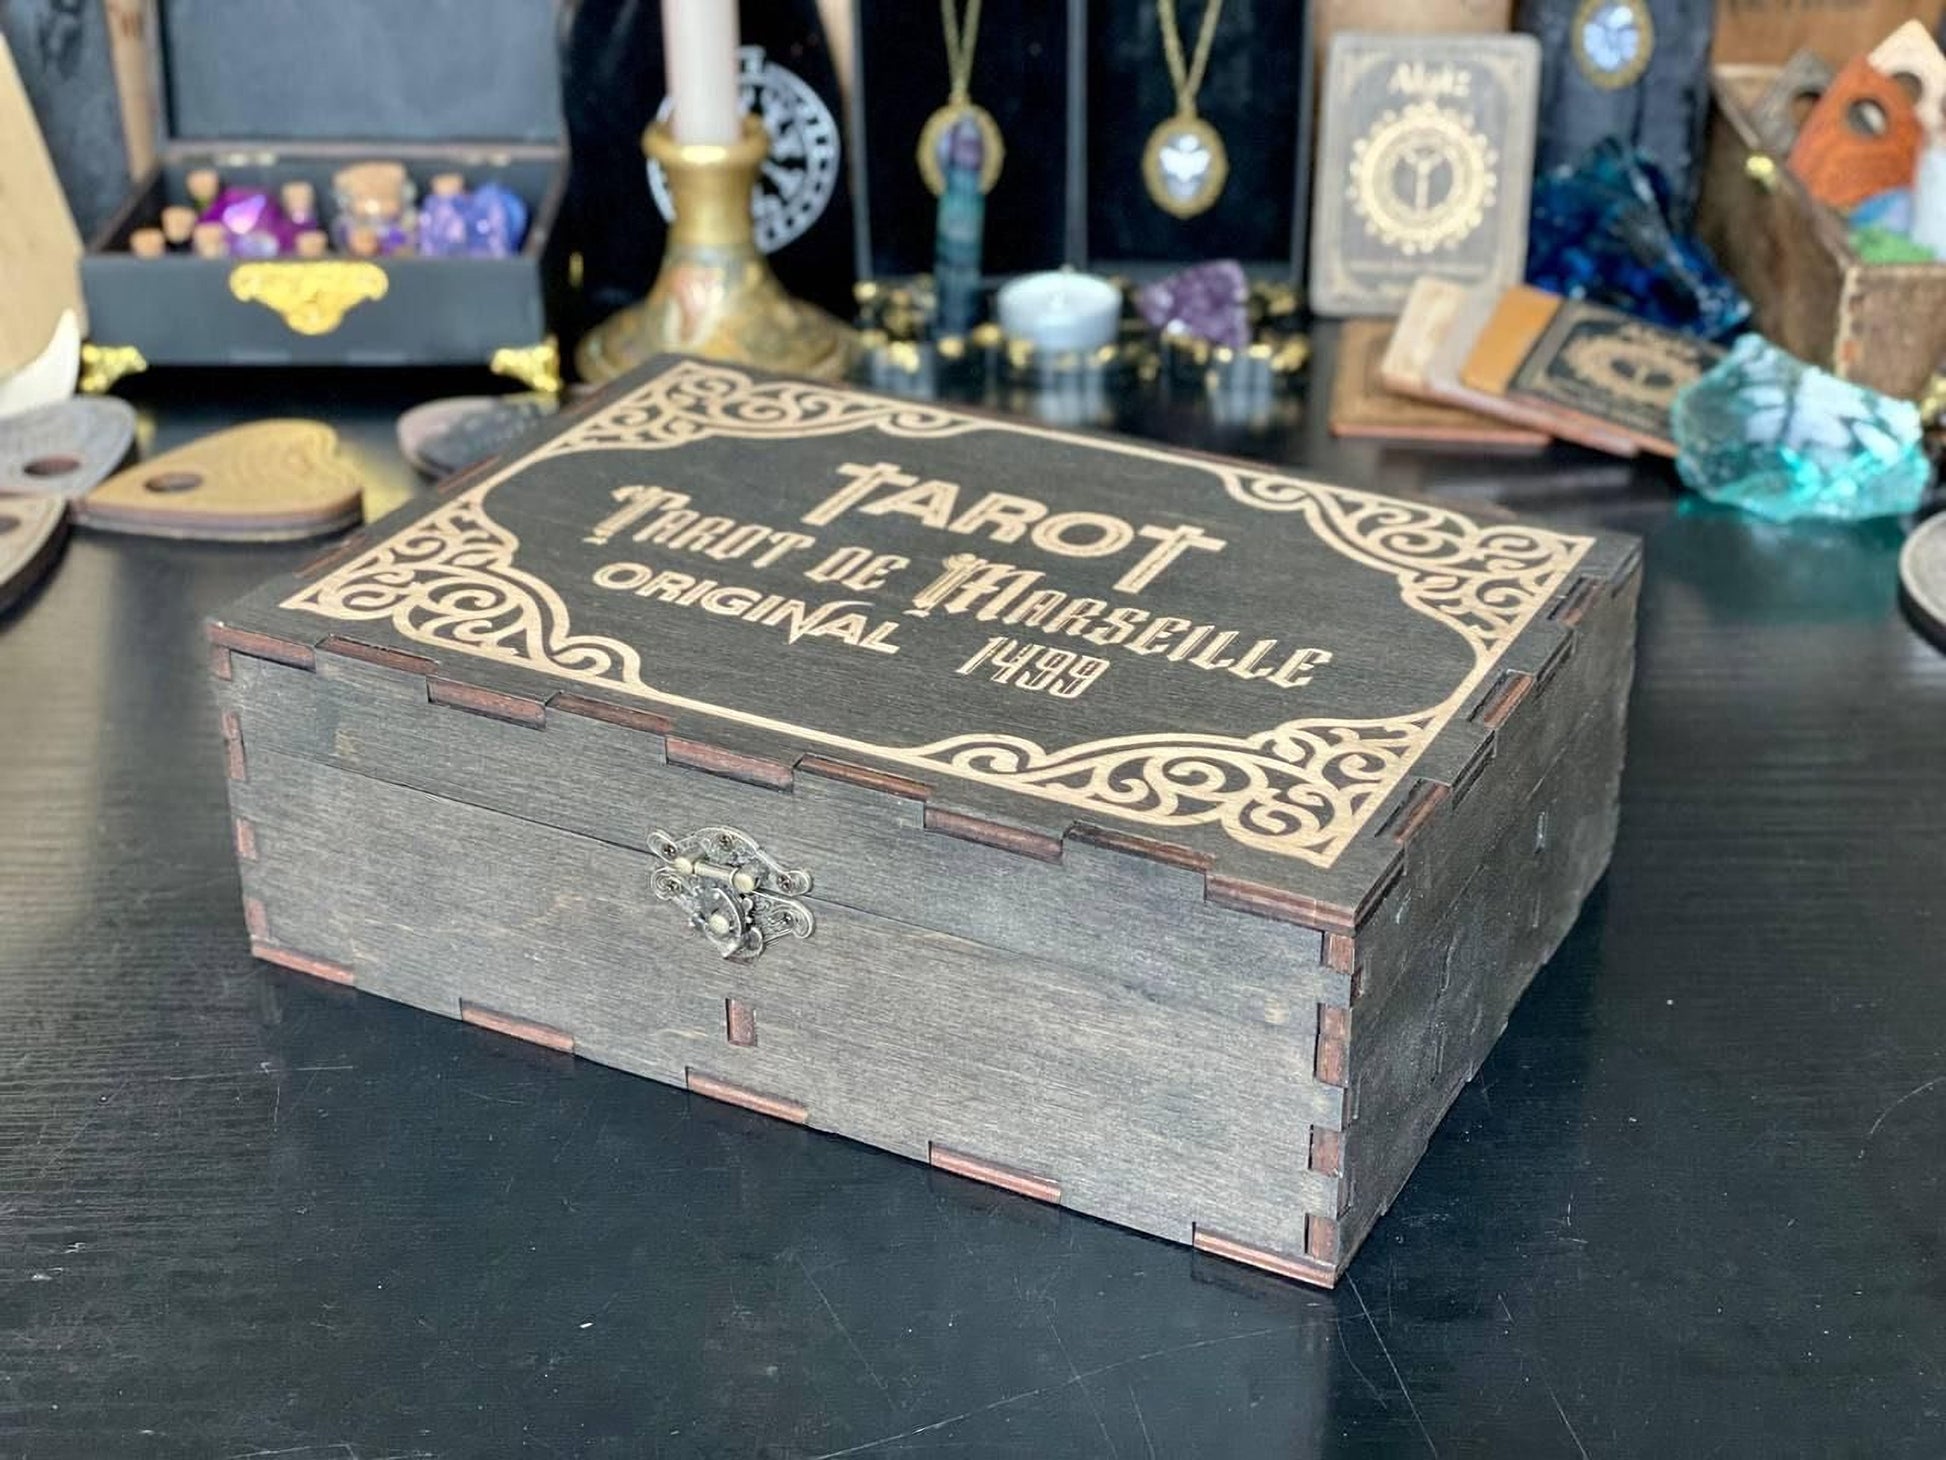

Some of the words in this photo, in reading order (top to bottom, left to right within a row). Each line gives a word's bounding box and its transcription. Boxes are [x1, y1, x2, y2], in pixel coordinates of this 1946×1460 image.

[801, 462, 1227, 594] TAROT
[592, 562, 901, 654] ORIGINAL
[955, 636, 1111, 699] 1499
